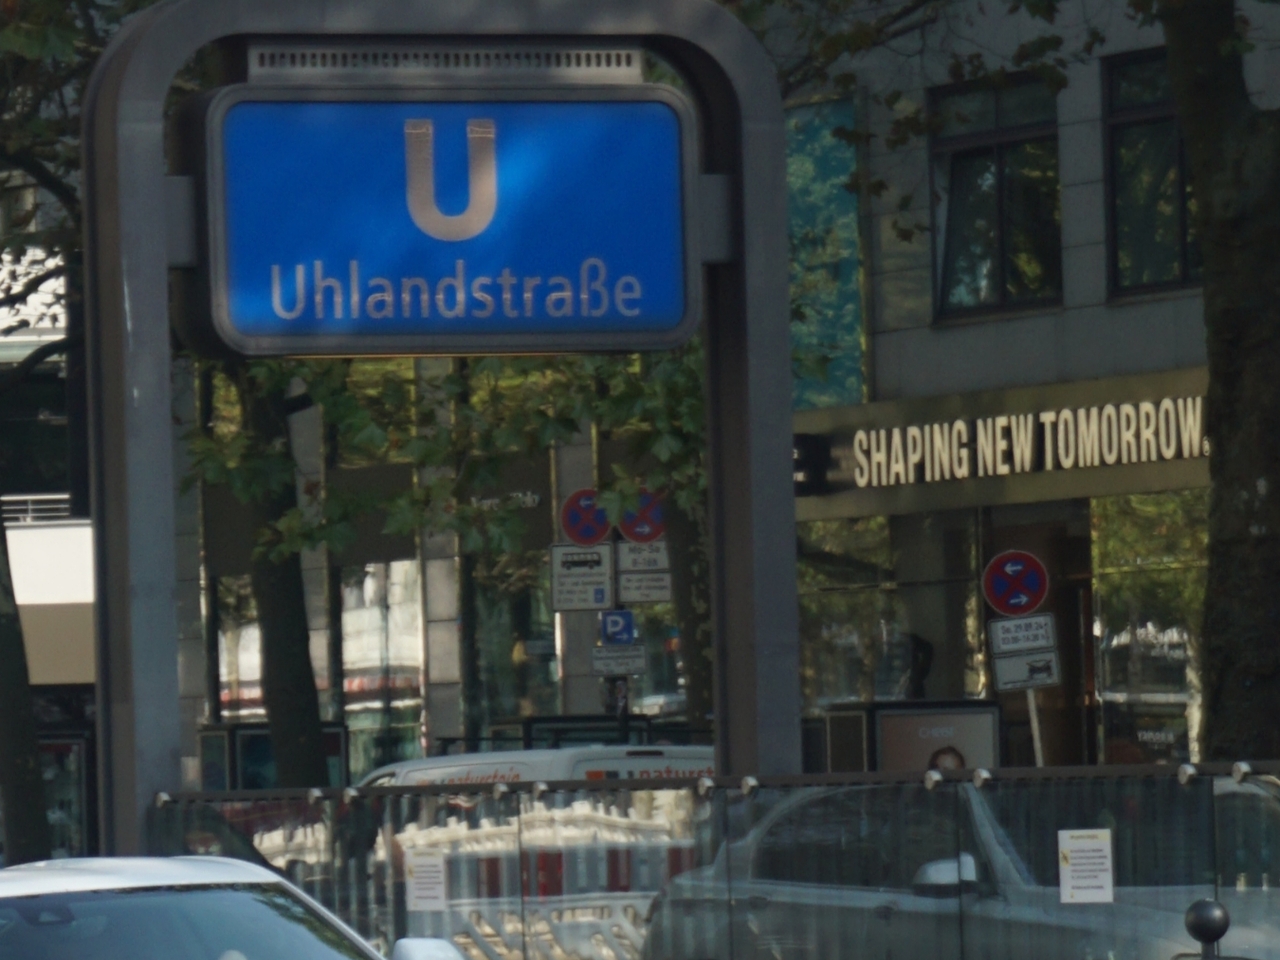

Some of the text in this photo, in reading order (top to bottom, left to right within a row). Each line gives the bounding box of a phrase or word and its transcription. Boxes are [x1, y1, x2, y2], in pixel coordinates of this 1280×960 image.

[405, 118, 498, 242] U
[270, 256, 643, 321] Uhlandstraße
[853, 418, 970, 489] SHAPING
[976, 413, 1034, 478] NEW
